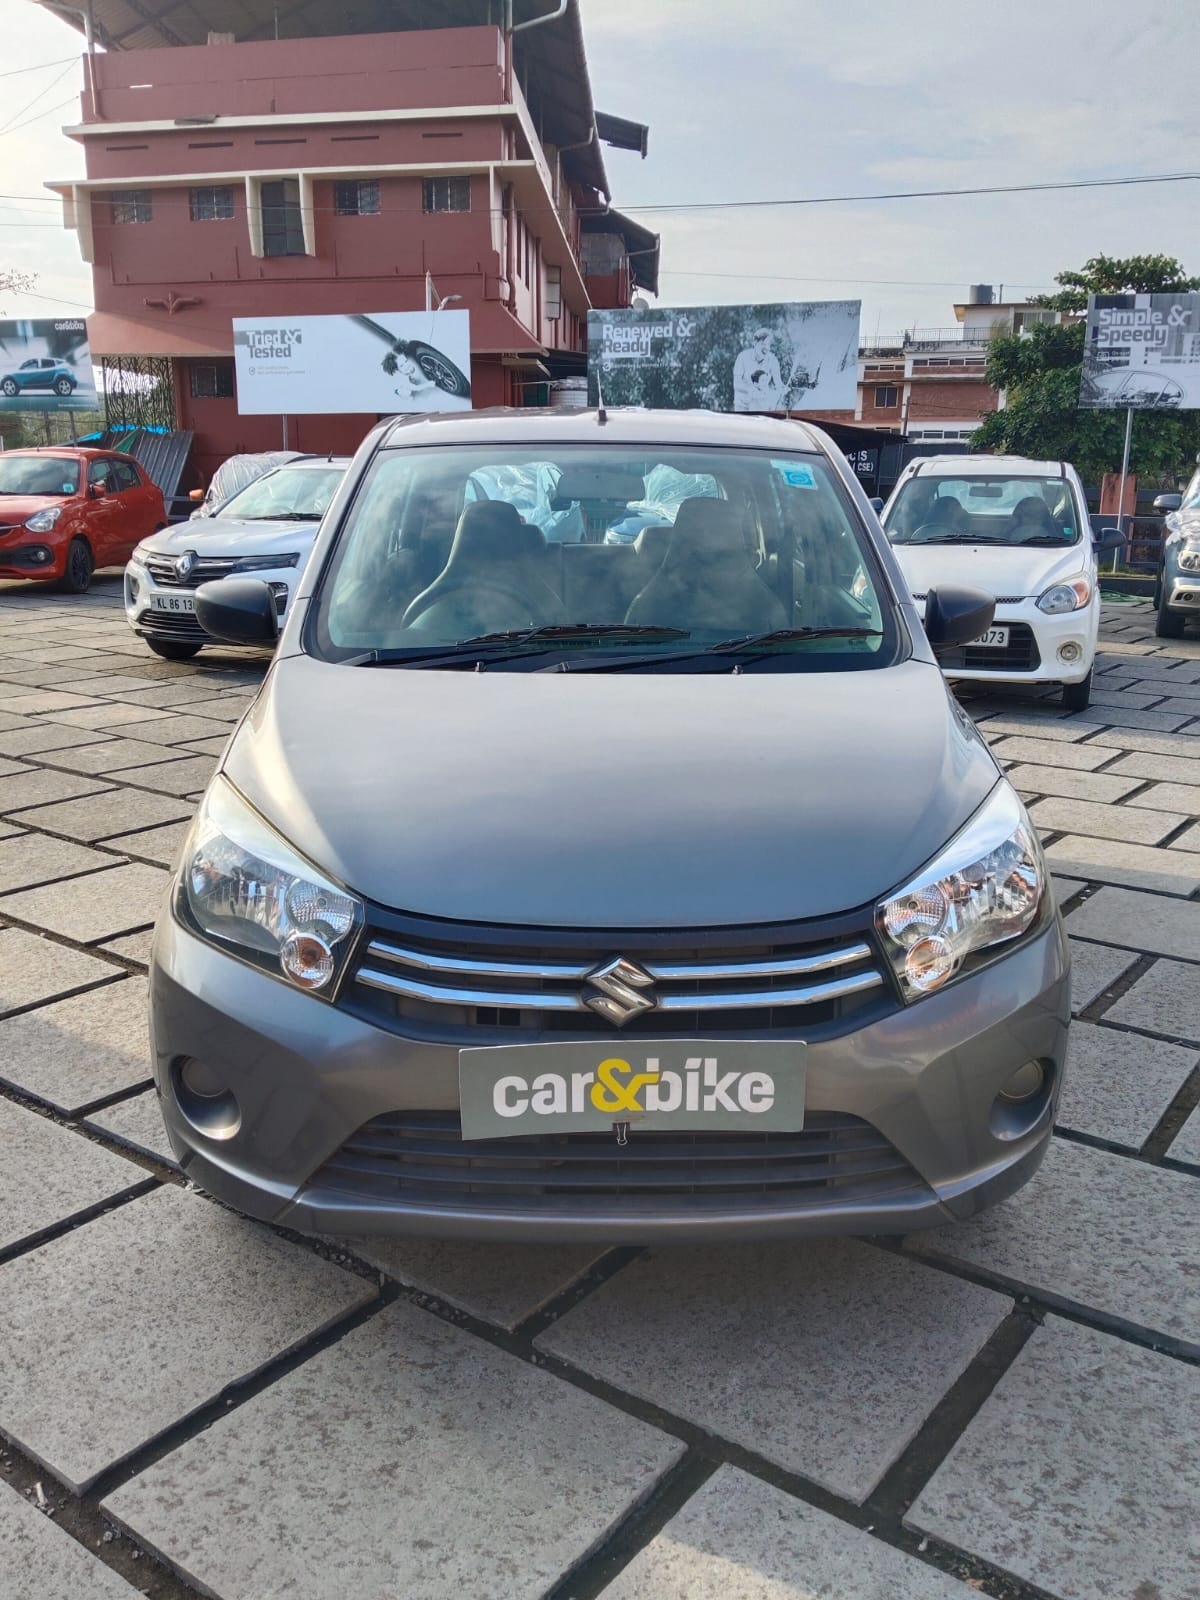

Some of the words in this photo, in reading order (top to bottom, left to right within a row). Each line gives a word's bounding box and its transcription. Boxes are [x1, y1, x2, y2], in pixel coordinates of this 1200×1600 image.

[1099, 307, 1163, 327] Simple
[1167, 304, 1193, 326] &
[246, 329, 281, 345] Tried
[602, 321, 673, 339] Renewed
[676, 317, 697, 337] &
[1099, 326, 1167, 346] Speedy
[247, 344, 291, 358] Tested
[603, 339, 649, 356] Ready
[157, 598, 167, 609] KL
[169, 599, 180, 610] 86
[183, 600, 195, 611] 13
[492, 1057, 776, 1118] car&bike
